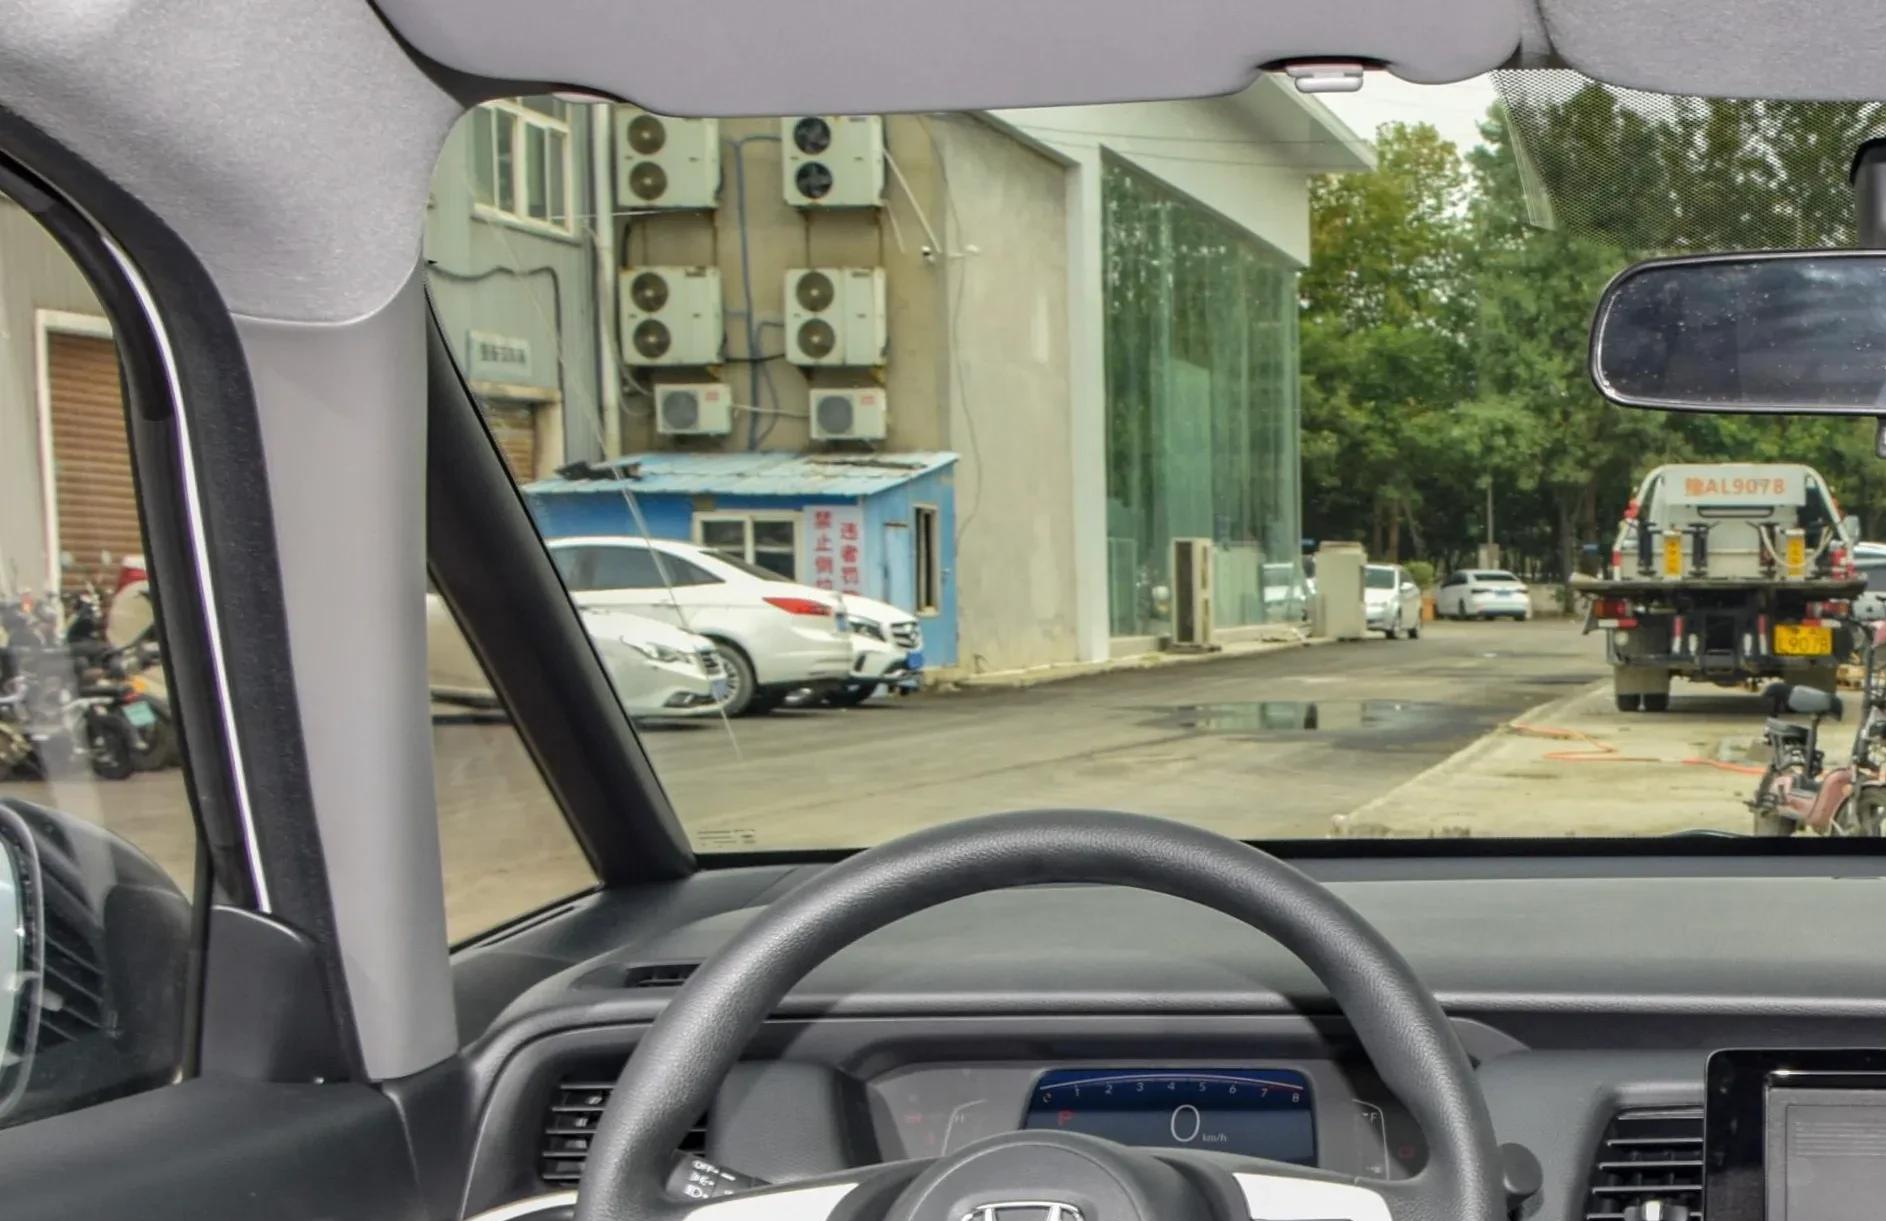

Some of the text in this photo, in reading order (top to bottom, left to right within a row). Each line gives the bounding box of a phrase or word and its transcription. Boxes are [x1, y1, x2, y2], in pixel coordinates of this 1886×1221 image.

[841, 522, 858, 595] 违者罚
[1105, 1083, 1113, 1094] 2
[1136, 1081, 1145, 1092] 3
[1167, 1081, 1176, 1091] 4
[1200, 1081, 1207, 1092] 5
[1229, 1083, 1237, 1094] 6
[1260, 1086, 1269, 1098] 7
[1291, 1092, 1301, 1103] 8
[1058, 1109, 1074, 1126] P
[1170, 1104, 1228, 1143] 0 km/h
